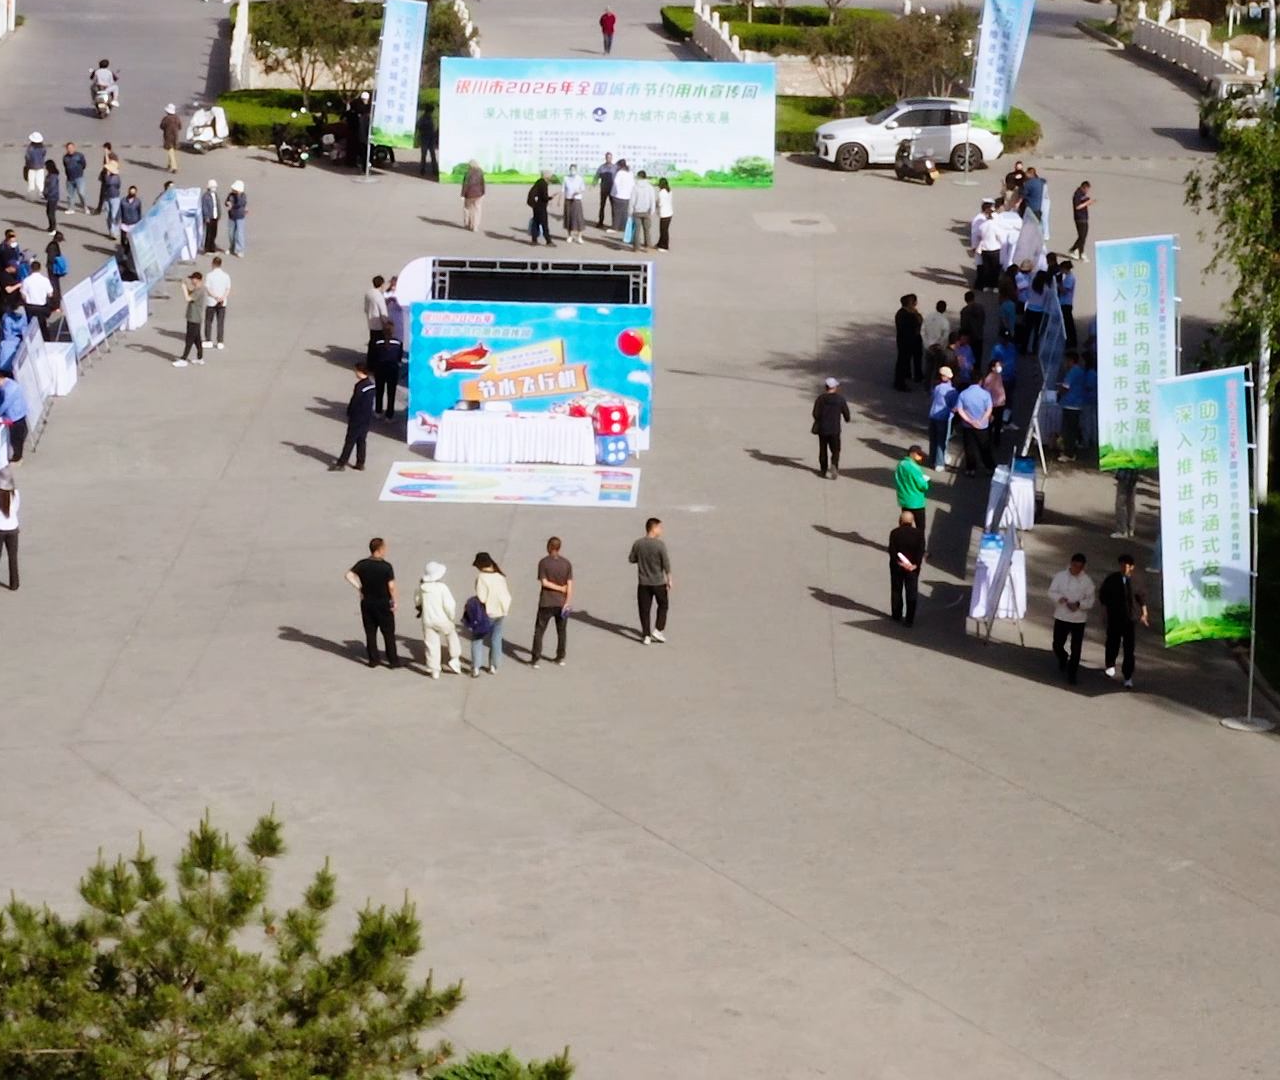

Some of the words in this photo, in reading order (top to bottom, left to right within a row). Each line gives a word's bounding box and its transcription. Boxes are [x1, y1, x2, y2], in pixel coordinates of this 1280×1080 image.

[1112, 264, 1130, 436] 深入推进城市节水
[1133, 262, 1152, 435] 助力城市内涵式发展
[1175, 405, 1195, 604] 深入推进城市节水
[1199, 400, 1221, 600] 助力城市内涵式发展
